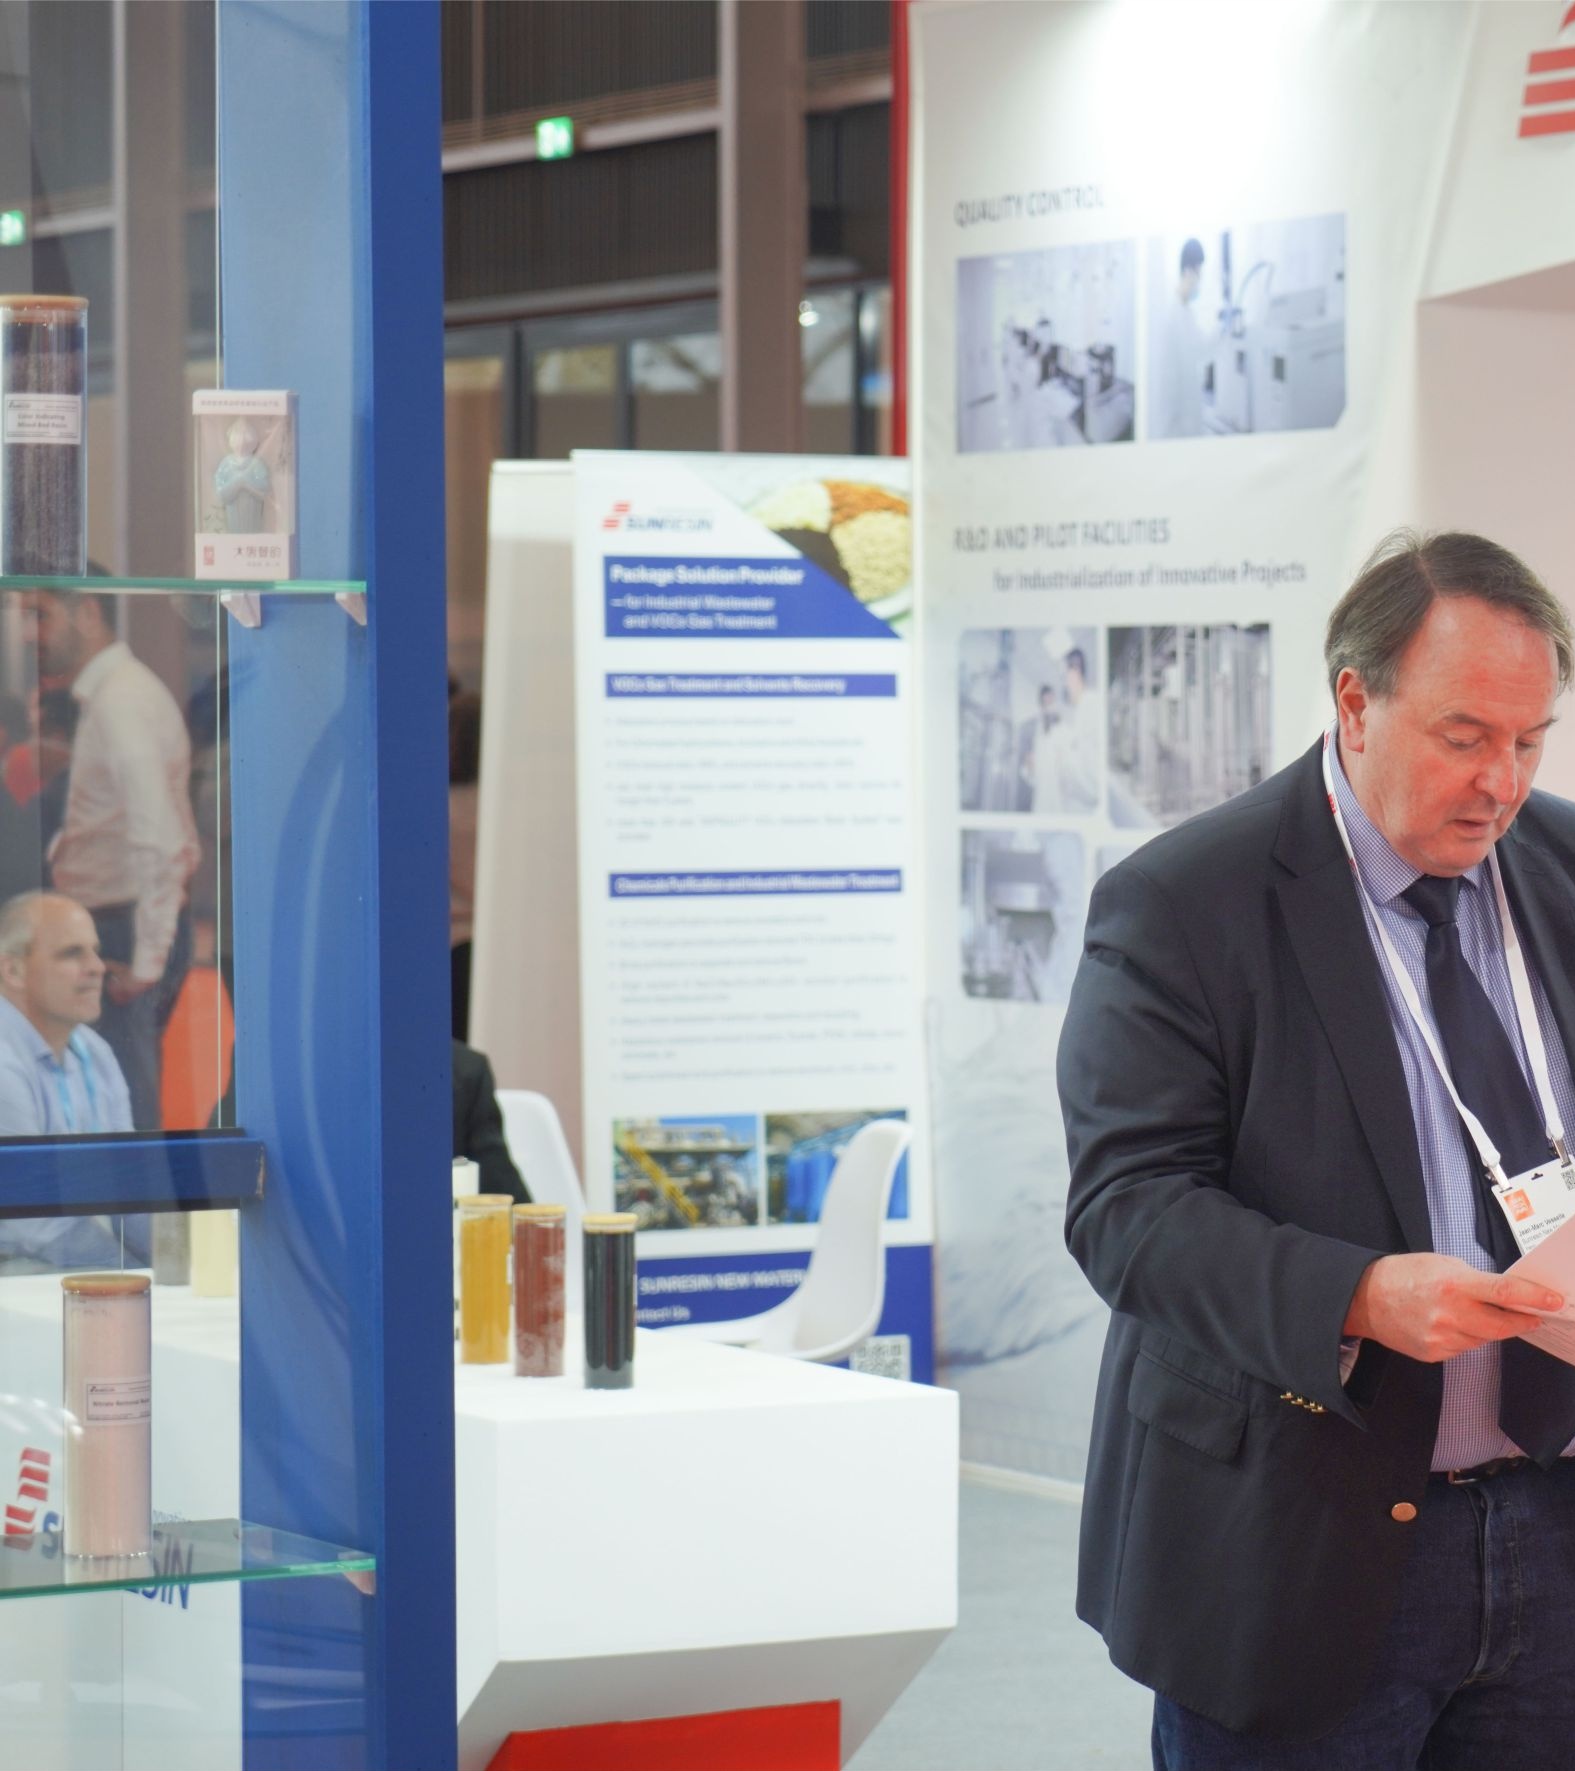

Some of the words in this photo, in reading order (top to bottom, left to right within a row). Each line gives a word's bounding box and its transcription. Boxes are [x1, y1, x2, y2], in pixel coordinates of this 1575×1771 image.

[954, 194, 1023, 228] QUALITY
[952, 526, 988, 551] R&D
[993, 525, 1029, 549] AND
[1033, 522, 1077, 548] PILOT
[1081, 518, 1171, 546] FACILITIES
[610, 564, 672, 588] Package
[674, 564, 740, 585] Solution
[741, 566, 804, 585] Provider
[993, 568, 1013, 592] for
[1137, 564, 1155, 586] of
[1240, 561, 1307, 588] Projects
[715, 615, 777, 630] Treatment
[640, 1273, 716, 1296] SUNRESIN
[716, 1271, 751, 1290] NEW
